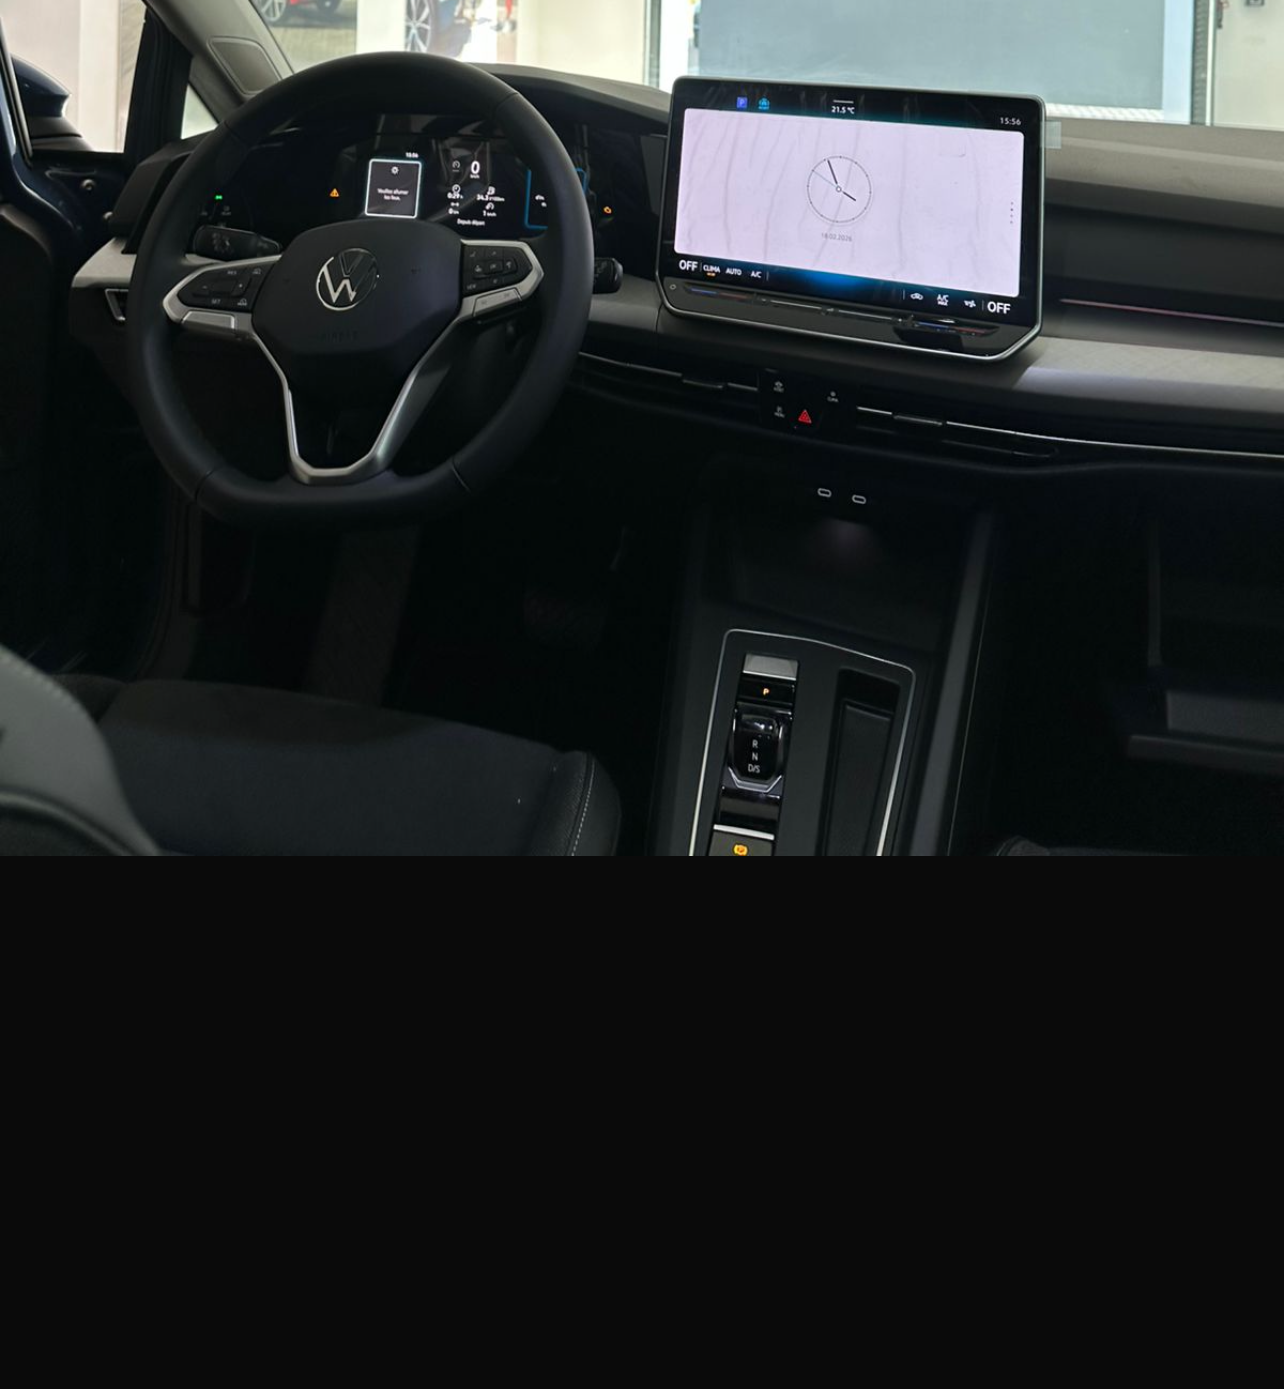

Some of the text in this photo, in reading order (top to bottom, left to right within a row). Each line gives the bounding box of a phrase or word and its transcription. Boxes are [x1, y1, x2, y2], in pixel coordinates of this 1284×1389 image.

[831, 105, 846, 114] 21.5
[1000, 117, 1021, 125] 15:56
[471, 161, 480, 174] 0
[679, 259, 762, 279] OFF CLIMA AUTO A/C
[936, 294, 949, 302] A/C
[987, 300, 1011, 314] OFF
[752, 739, 758, 748] R
[752, 753, 758, 761] N
[748, 764, 760, 773] D/S
